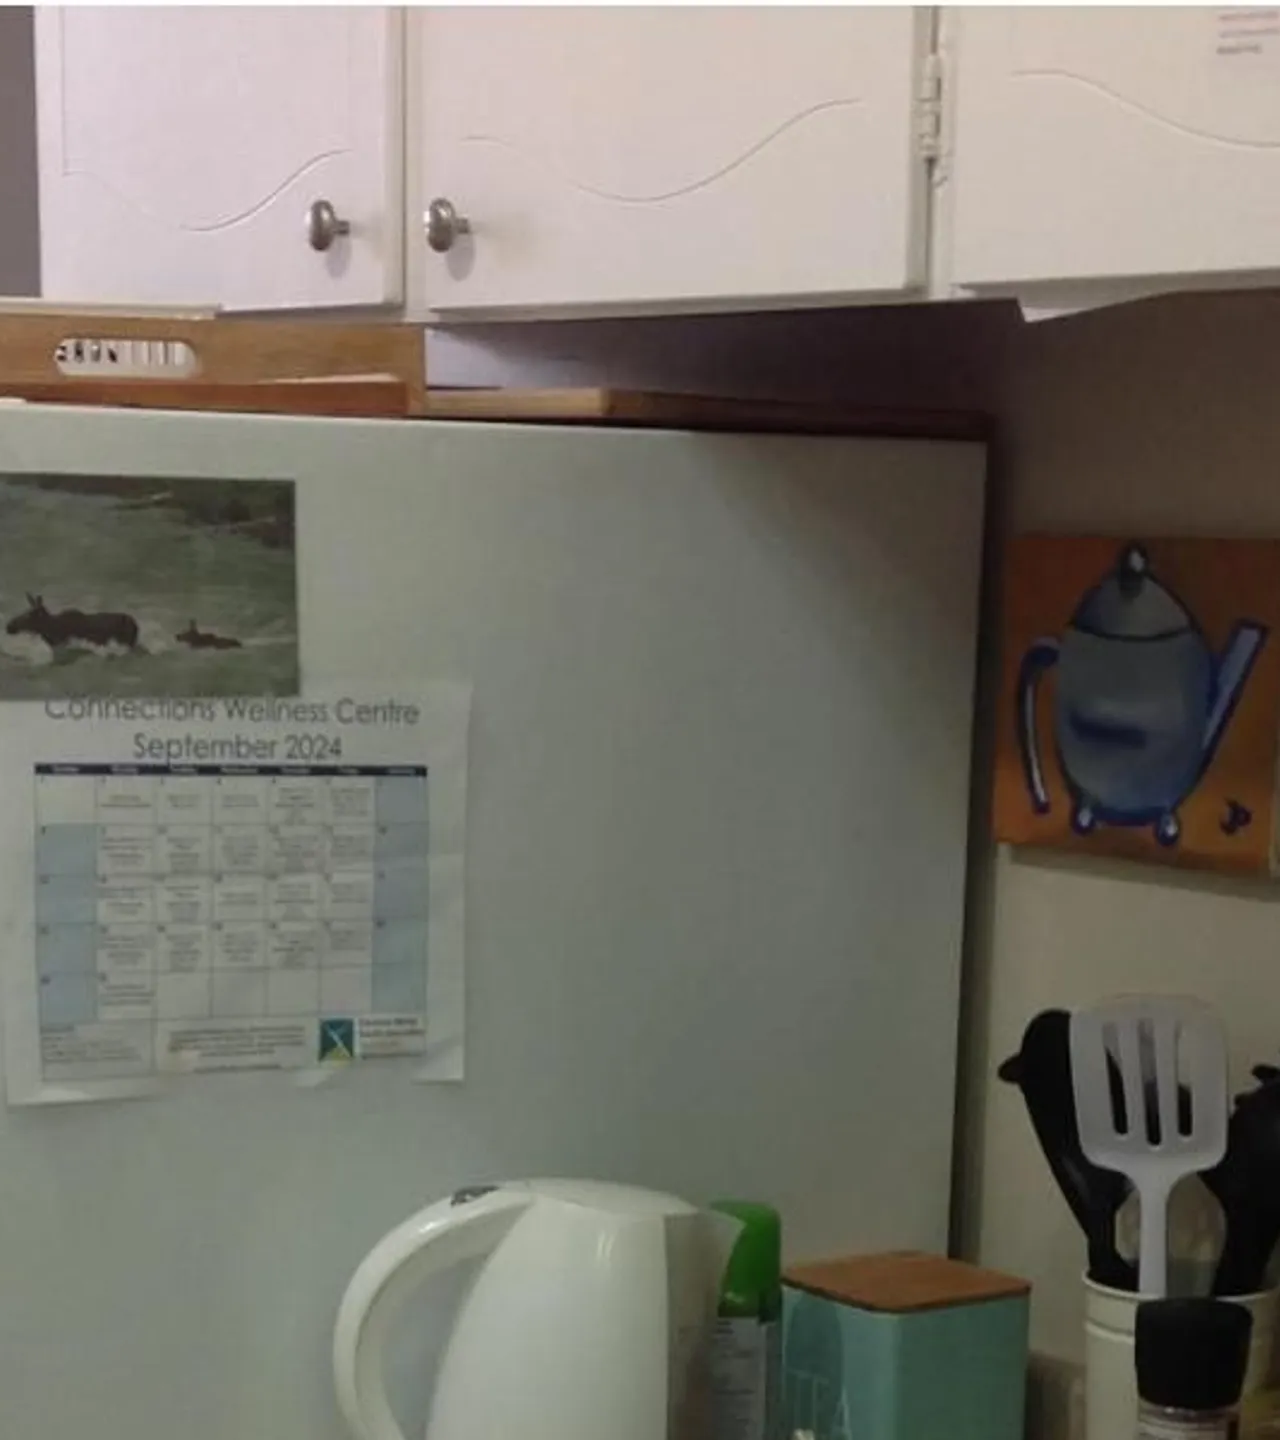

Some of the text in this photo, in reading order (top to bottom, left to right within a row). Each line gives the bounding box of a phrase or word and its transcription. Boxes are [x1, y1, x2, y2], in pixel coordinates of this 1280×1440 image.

[224, 697, 330, 723] Wellness
[336, 697, 421, 726] Centre
[133, 732, 343, 765] September 2024
